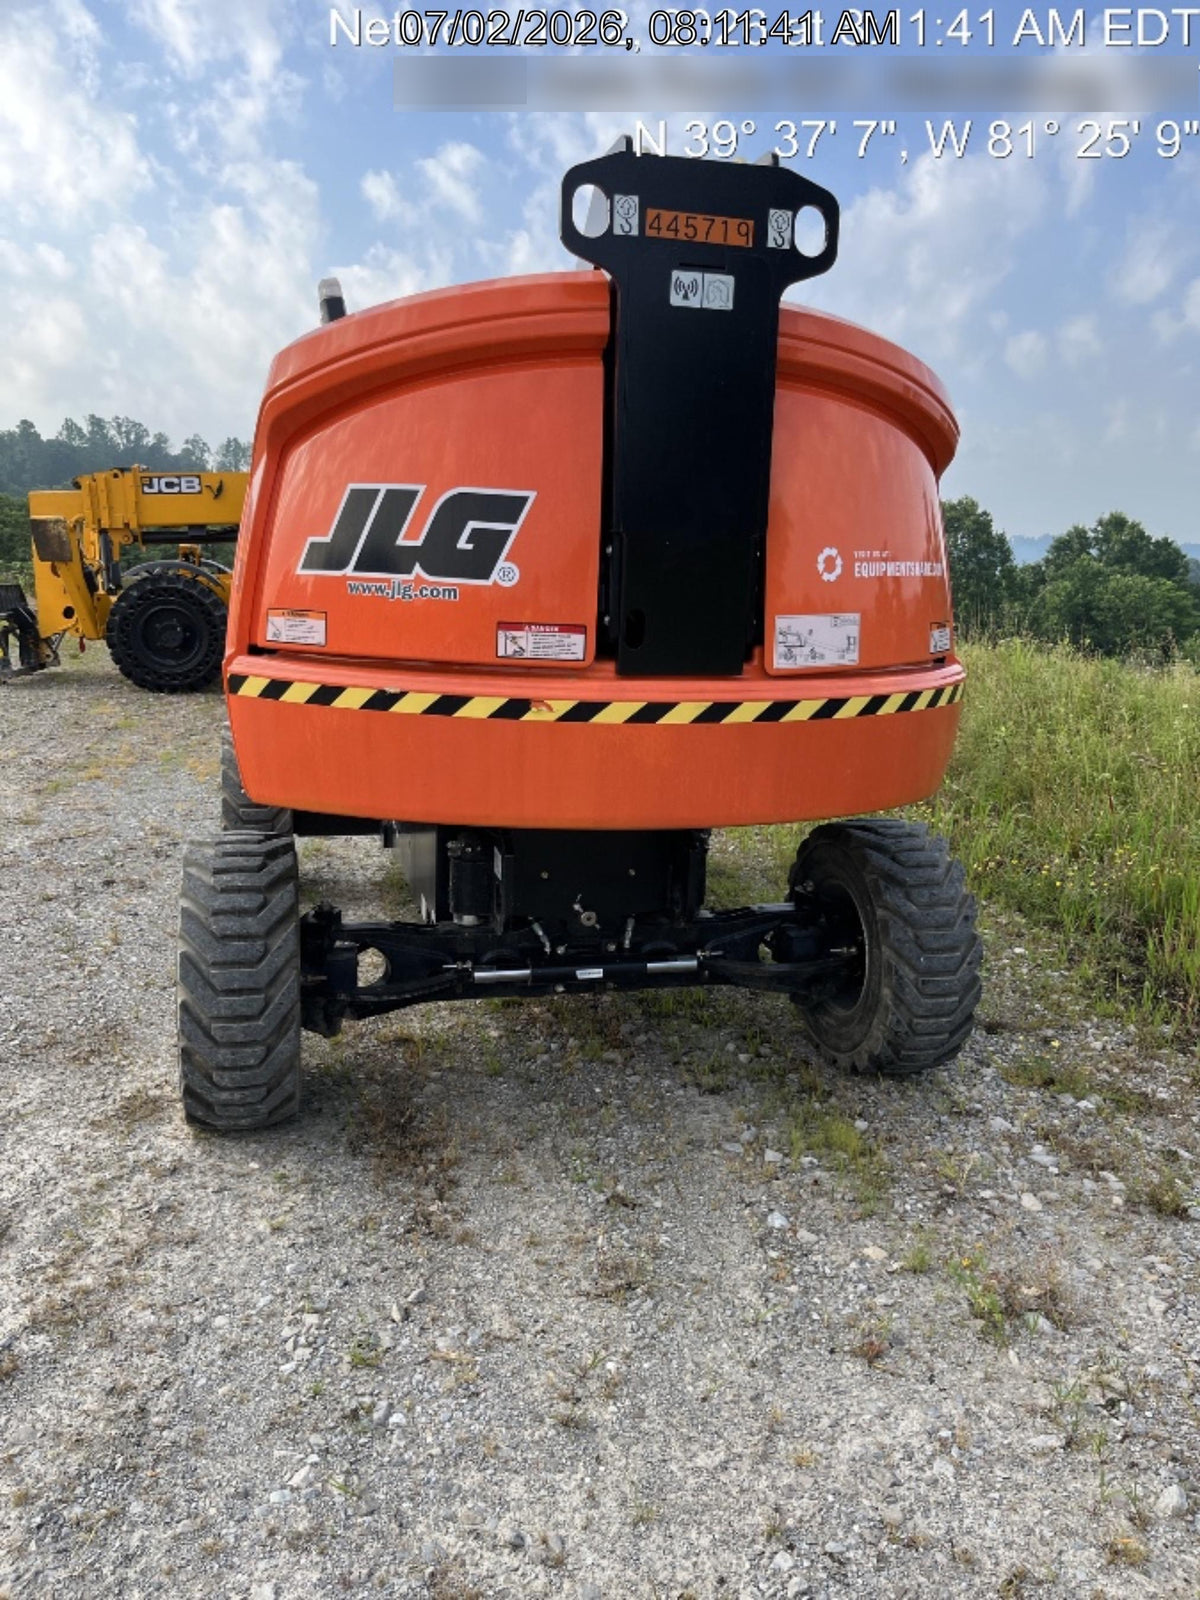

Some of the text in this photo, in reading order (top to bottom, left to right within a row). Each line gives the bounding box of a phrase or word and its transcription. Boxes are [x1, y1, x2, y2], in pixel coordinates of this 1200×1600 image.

[648, 211, 751, 246] 445719
[142, 476, 202, 494] JCB
[296, 483, 538, 586] JLG
[347, 579, 460, 602] www.jlg.com
